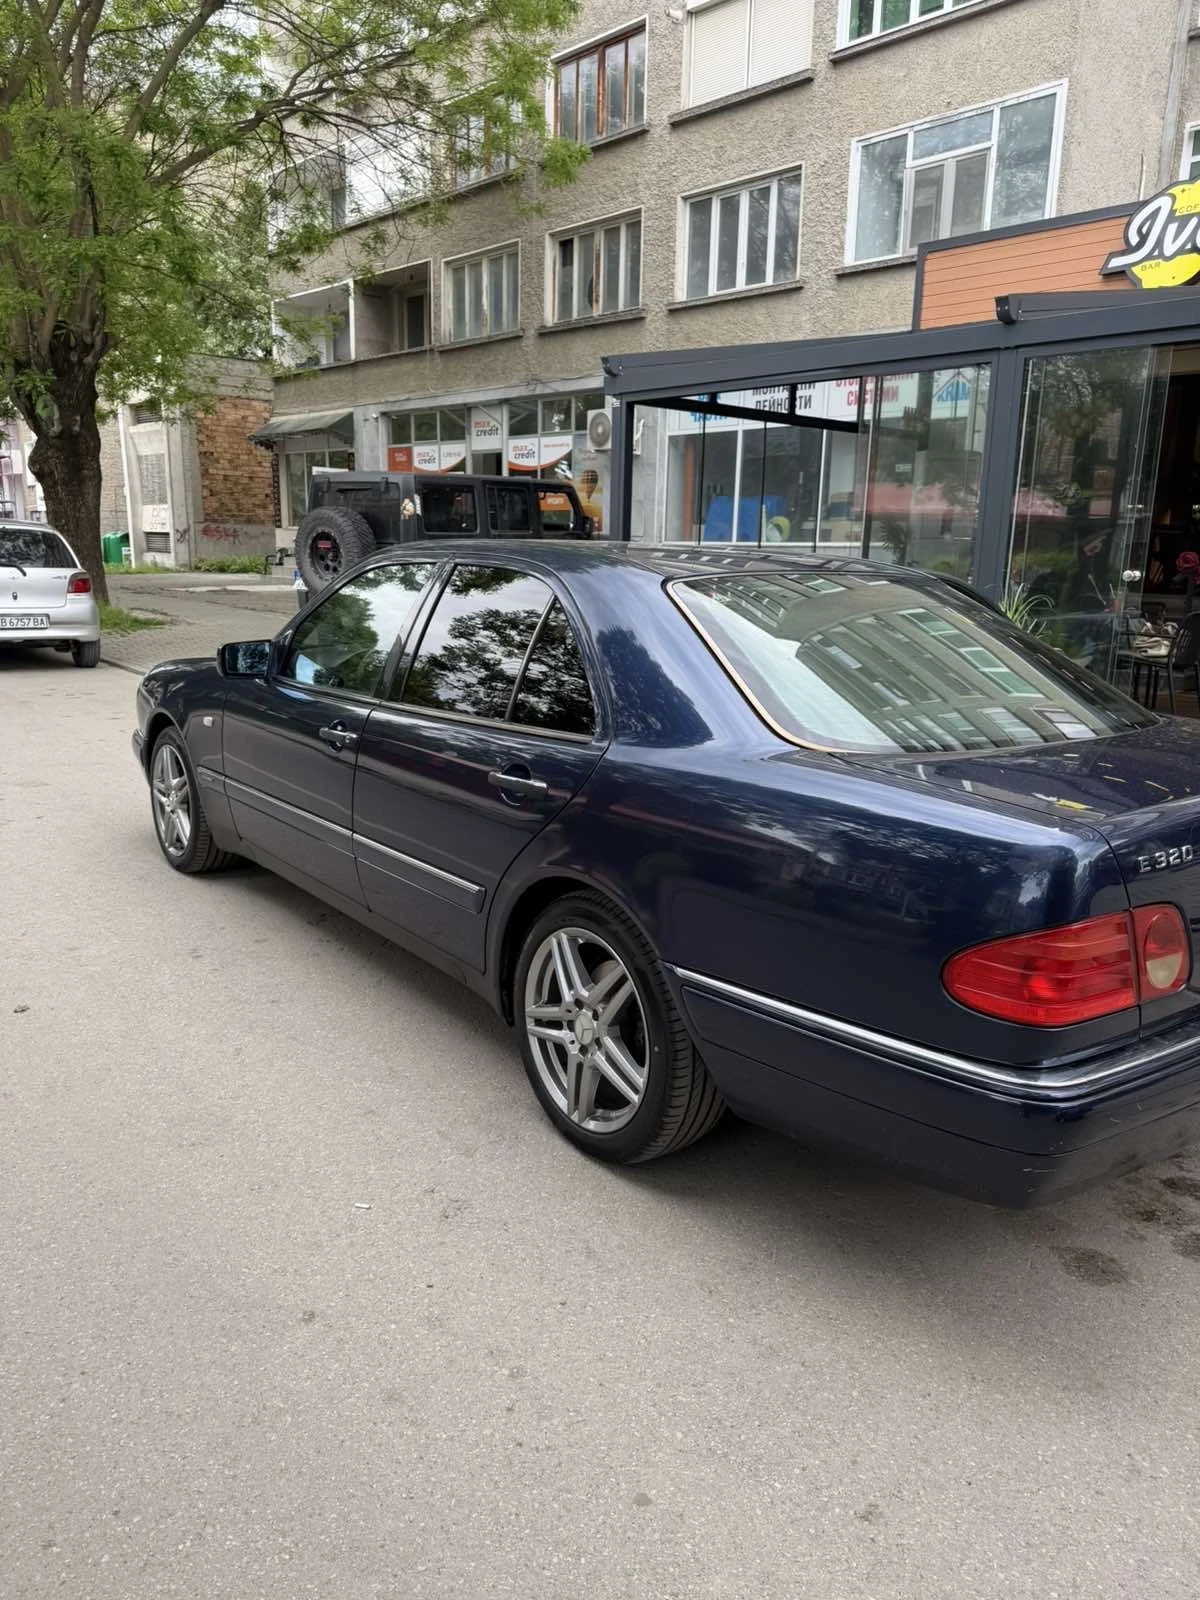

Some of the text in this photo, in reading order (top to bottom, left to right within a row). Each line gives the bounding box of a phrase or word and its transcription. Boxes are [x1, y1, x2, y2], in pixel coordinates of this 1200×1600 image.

[755, 394, 812, 413] ДЕЙНОТИ
[476, 424, 499, 437] credit
[514, 448, 536, 460] credit
[9, 617, 31, 627] 6757
[1155, 845, 1194, 869] 320
